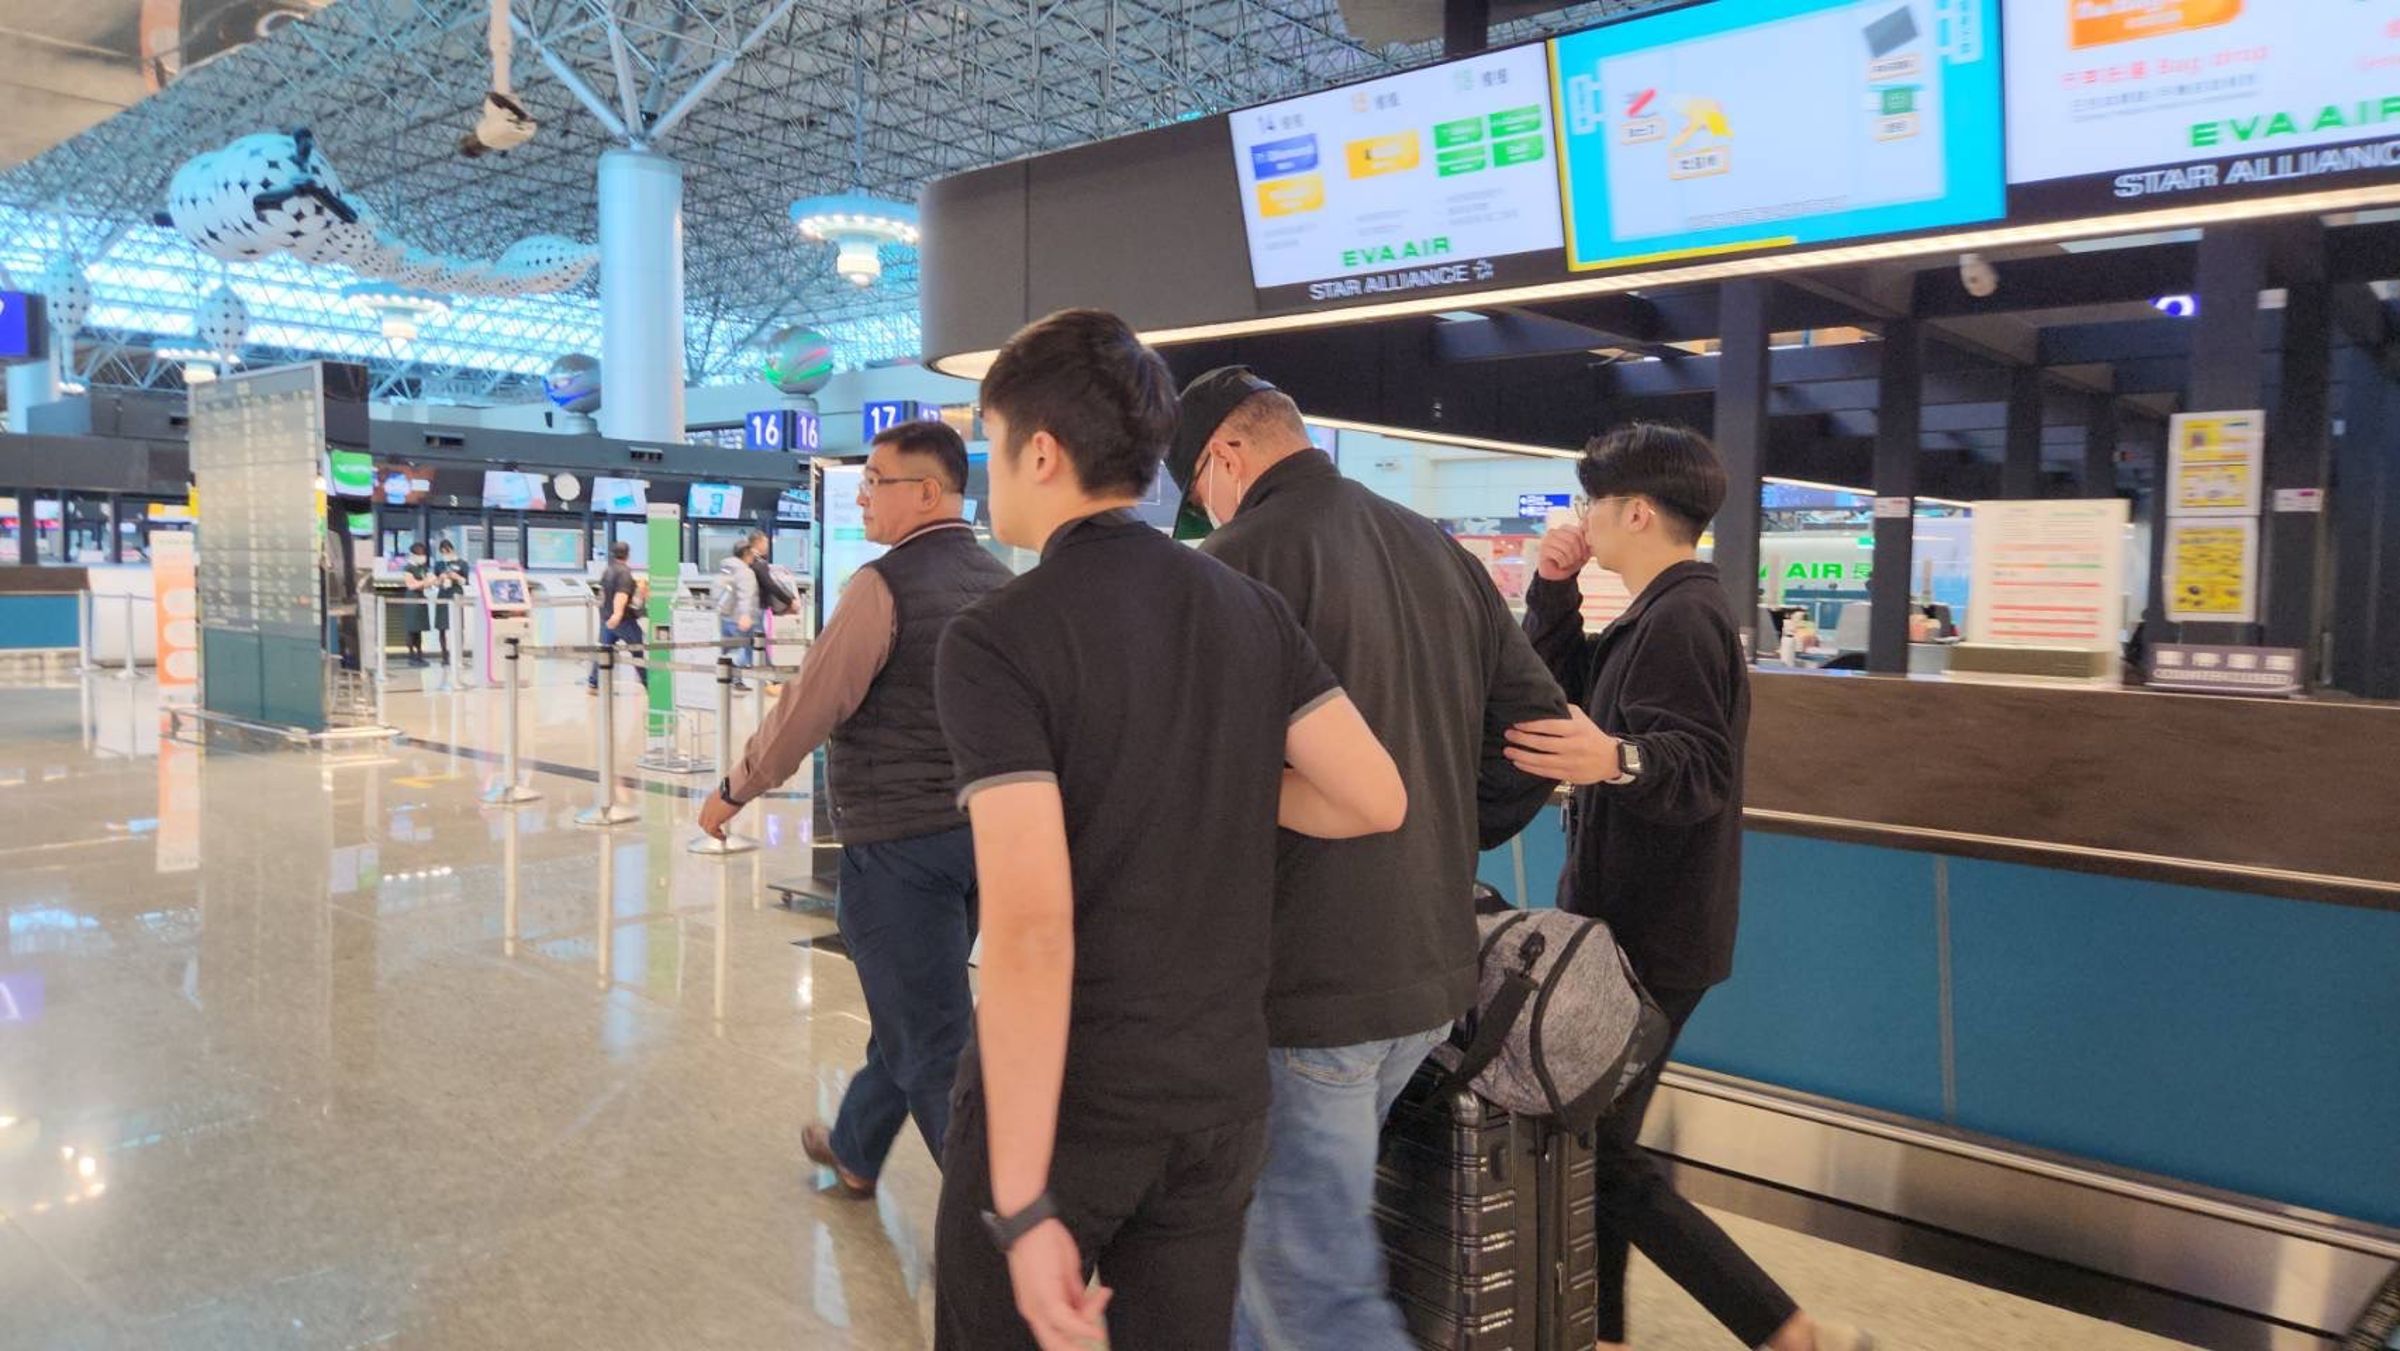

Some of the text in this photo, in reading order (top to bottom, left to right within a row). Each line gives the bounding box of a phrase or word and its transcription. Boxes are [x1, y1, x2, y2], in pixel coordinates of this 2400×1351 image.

[2190, 95, 2400, 148] EVA AIR
[2113, 163, 2218, 198] STAR
[1342, 236, 1451, 267] EVA AIR
[1308, 264, 1471, 301] STAR ALLIANCE
[751, 413, 780, 446] 16
[799, 415, 819, 449] 16
[870, 405, 897, 435] 17
[1786, 562, 1843, 579] AIR
